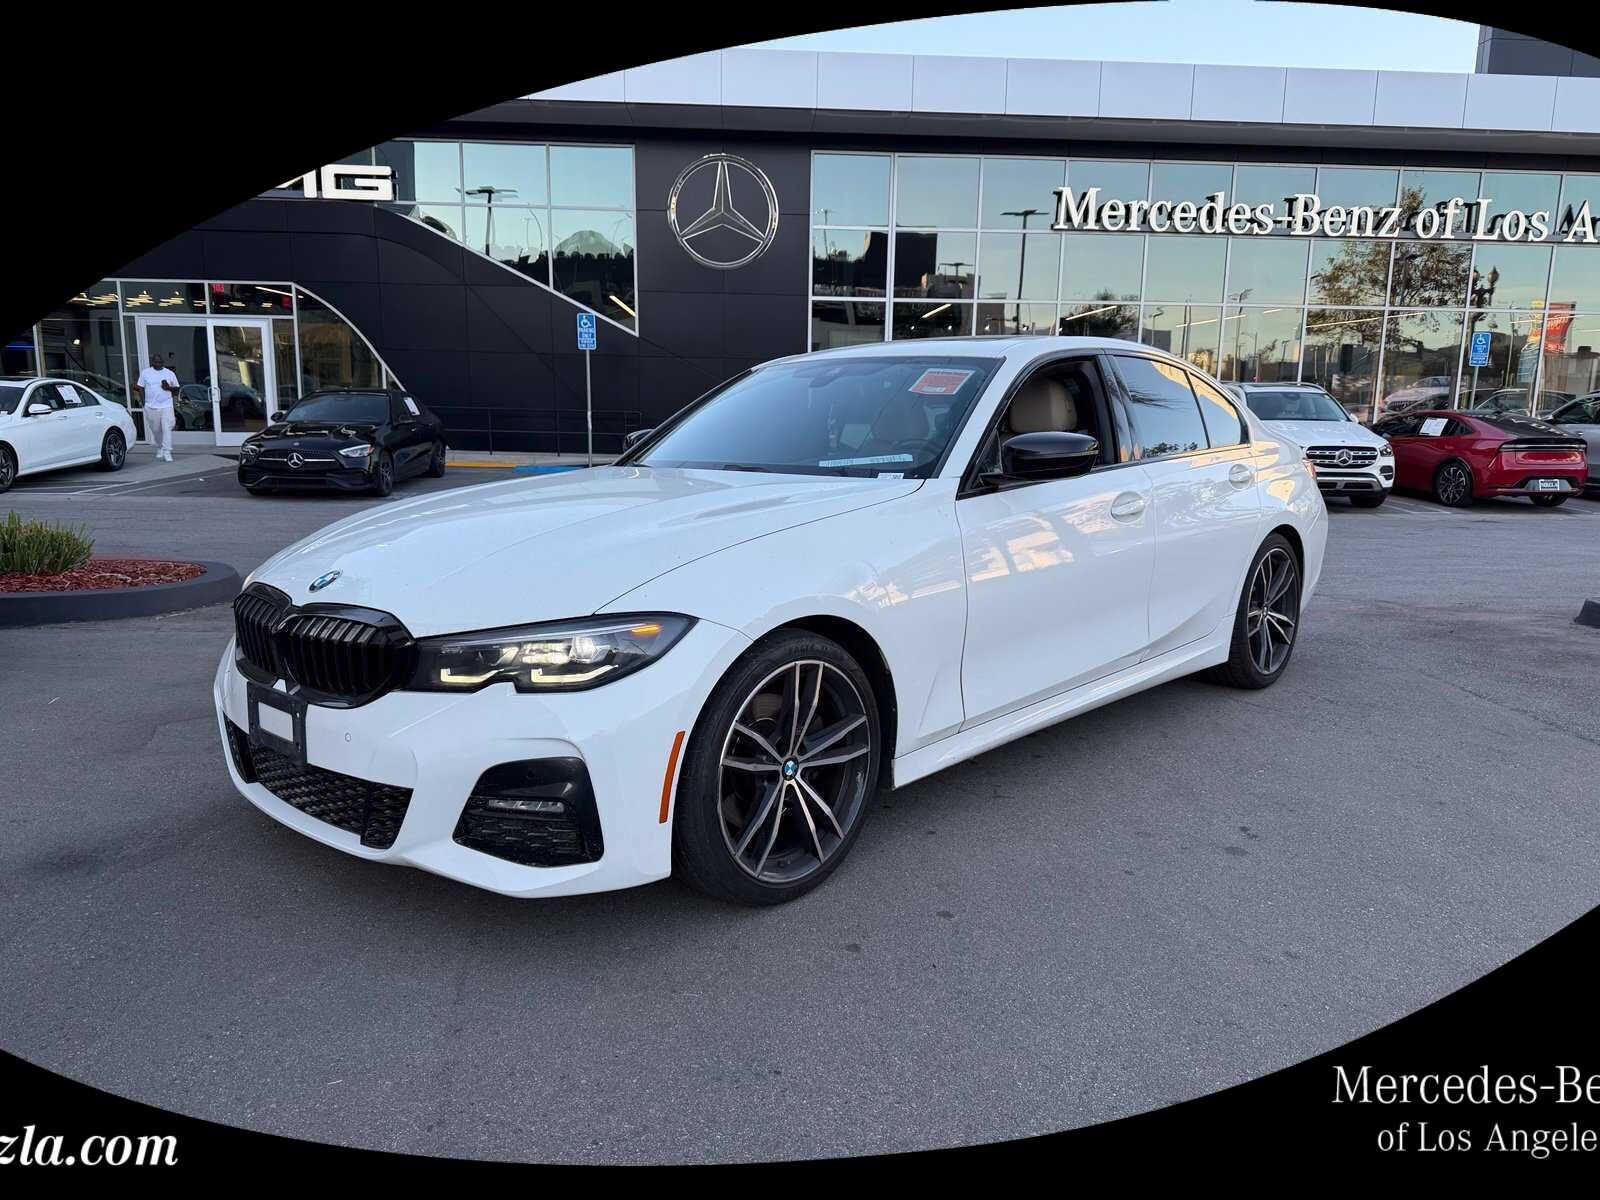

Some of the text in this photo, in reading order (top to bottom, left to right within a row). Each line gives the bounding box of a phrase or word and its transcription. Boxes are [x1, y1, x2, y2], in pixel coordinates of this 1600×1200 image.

[1053, 186, 1599, 243] Mercedes-Benz of Los A
